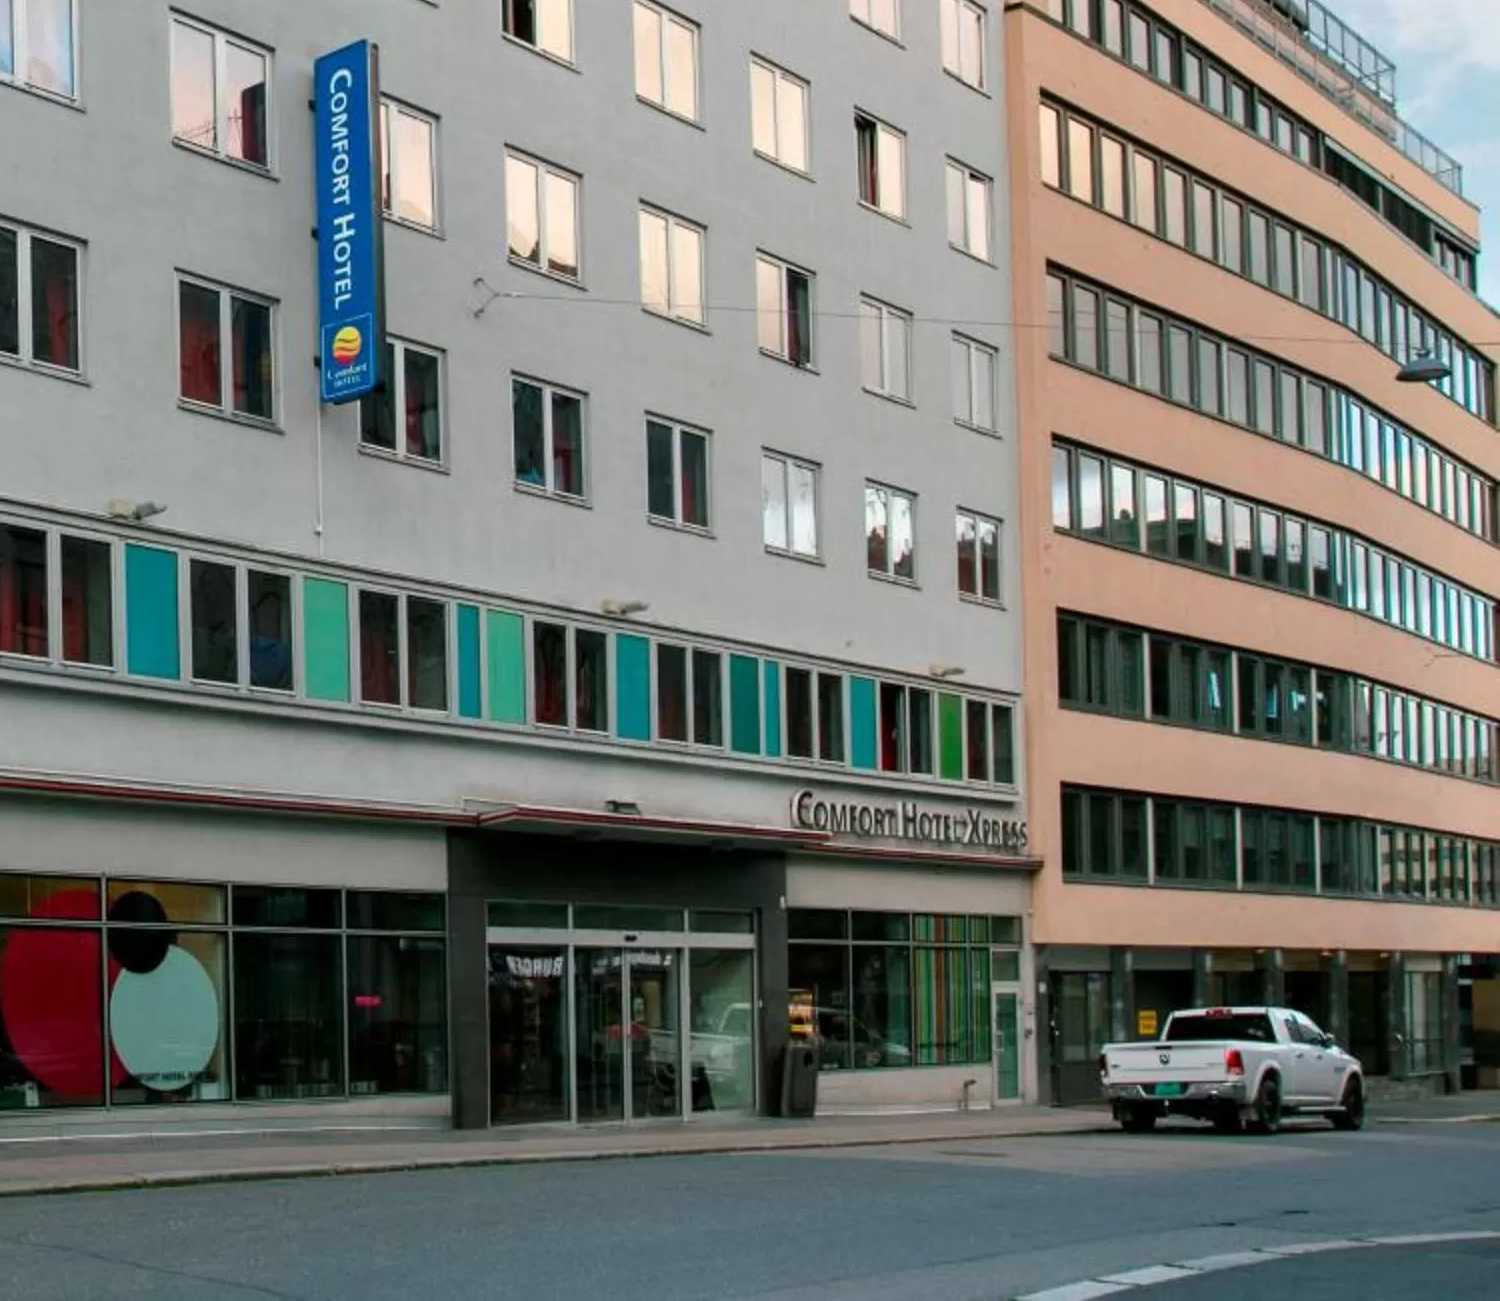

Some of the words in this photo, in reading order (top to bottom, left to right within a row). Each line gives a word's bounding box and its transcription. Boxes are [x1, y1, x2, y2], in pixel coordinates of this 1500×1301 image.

[328, 67, 353, 205] COMFORT
[332, 213, 356, 312] HOTEL
[790, 789, 898, 837] COMFORT
[898, 801, 966, 843] HOTEL
[966, 808, 1029, 849] XPRESS
